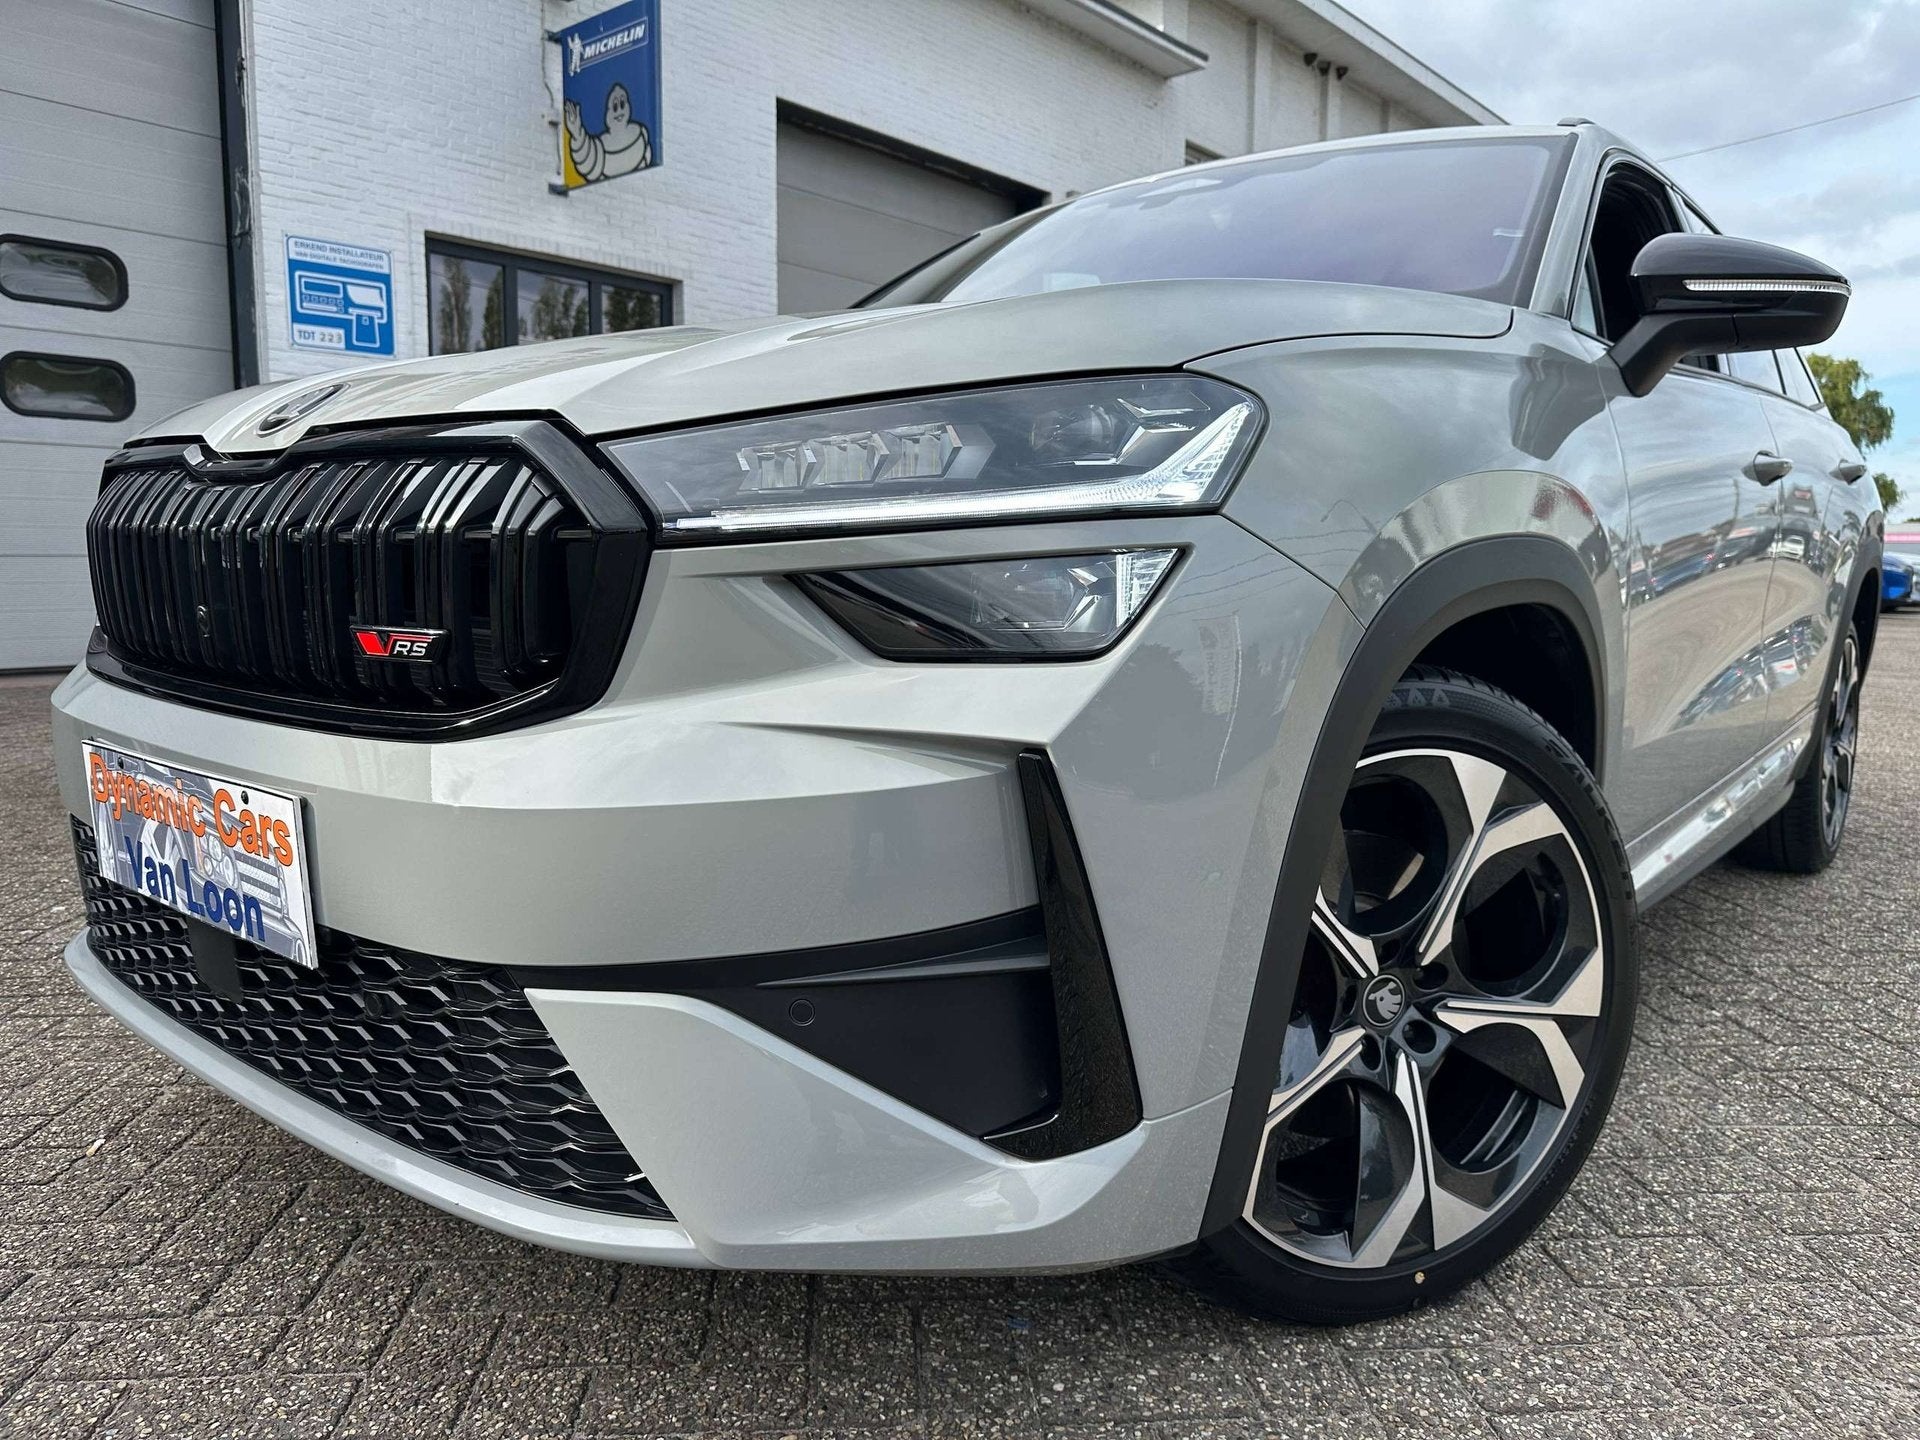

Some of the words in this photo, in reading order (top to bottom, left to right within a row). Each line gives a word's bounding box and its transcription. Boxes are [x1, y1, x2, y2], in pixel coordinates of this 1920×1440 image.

[584, 24, 645, 59] MICHELIN
[294, 241, 327, 252] ERKEND
[298, 330, 315, 340] TDT
[90, 752, 205, 838] Dynamic
[213, 788, 294, 866] Cars
[125, 836, 177, 905] Van
[182, 859, 265, 942] Loon
